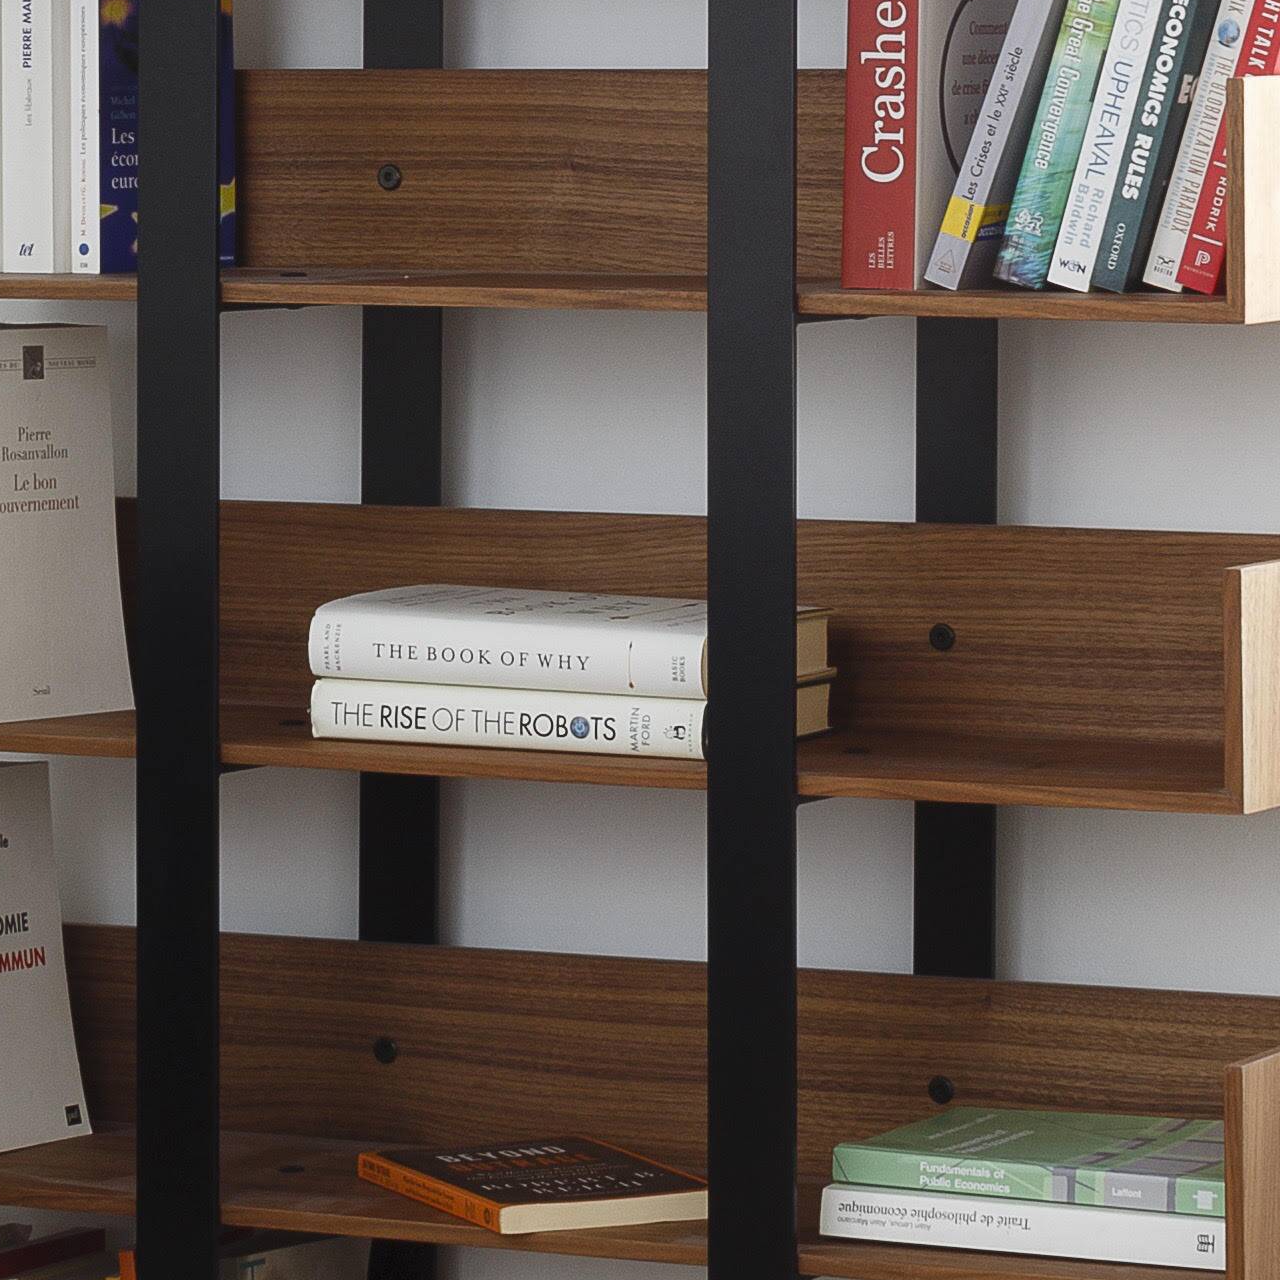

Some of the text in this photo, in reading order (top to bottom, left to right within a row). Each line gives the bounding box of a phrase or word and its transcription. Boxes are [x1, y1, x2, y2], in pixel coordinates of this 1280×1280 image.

[22, 27, 33, 68] PIERRE
[1064, 17, 1093, 63] Great
[1248, 25, 1276, 71] TALK
[111, 128, 135, 145] Les
[1035, 66, 1081, 170] Convergence
[1085, 61, 1133, 180] UPHEAVAL
[1122, 133, 1153, 200] RULES
[1064, 184, 1090, 246] Baldwin
[1079, 188, 1105, 249] Richard
[1107, 222, 1126, 270] OXFORD
[2, 445, 69, 462] Rosanvallon
[18, 426, 51, 442] Pierre
[13, 472, 57, 492] Le bon
[372, 643, 590, 671] THE BOOK OF WHY
[331, 701, 616, 741] THE RISE OF THE ROBOTS
[631, 707, 640, 752] MARTIN
[641, 714, 651, 746] FORD
[436, 1146, 567, 1163] BEYOND
[838, 1201, 1031, 1231] Traité de philosophie économique
